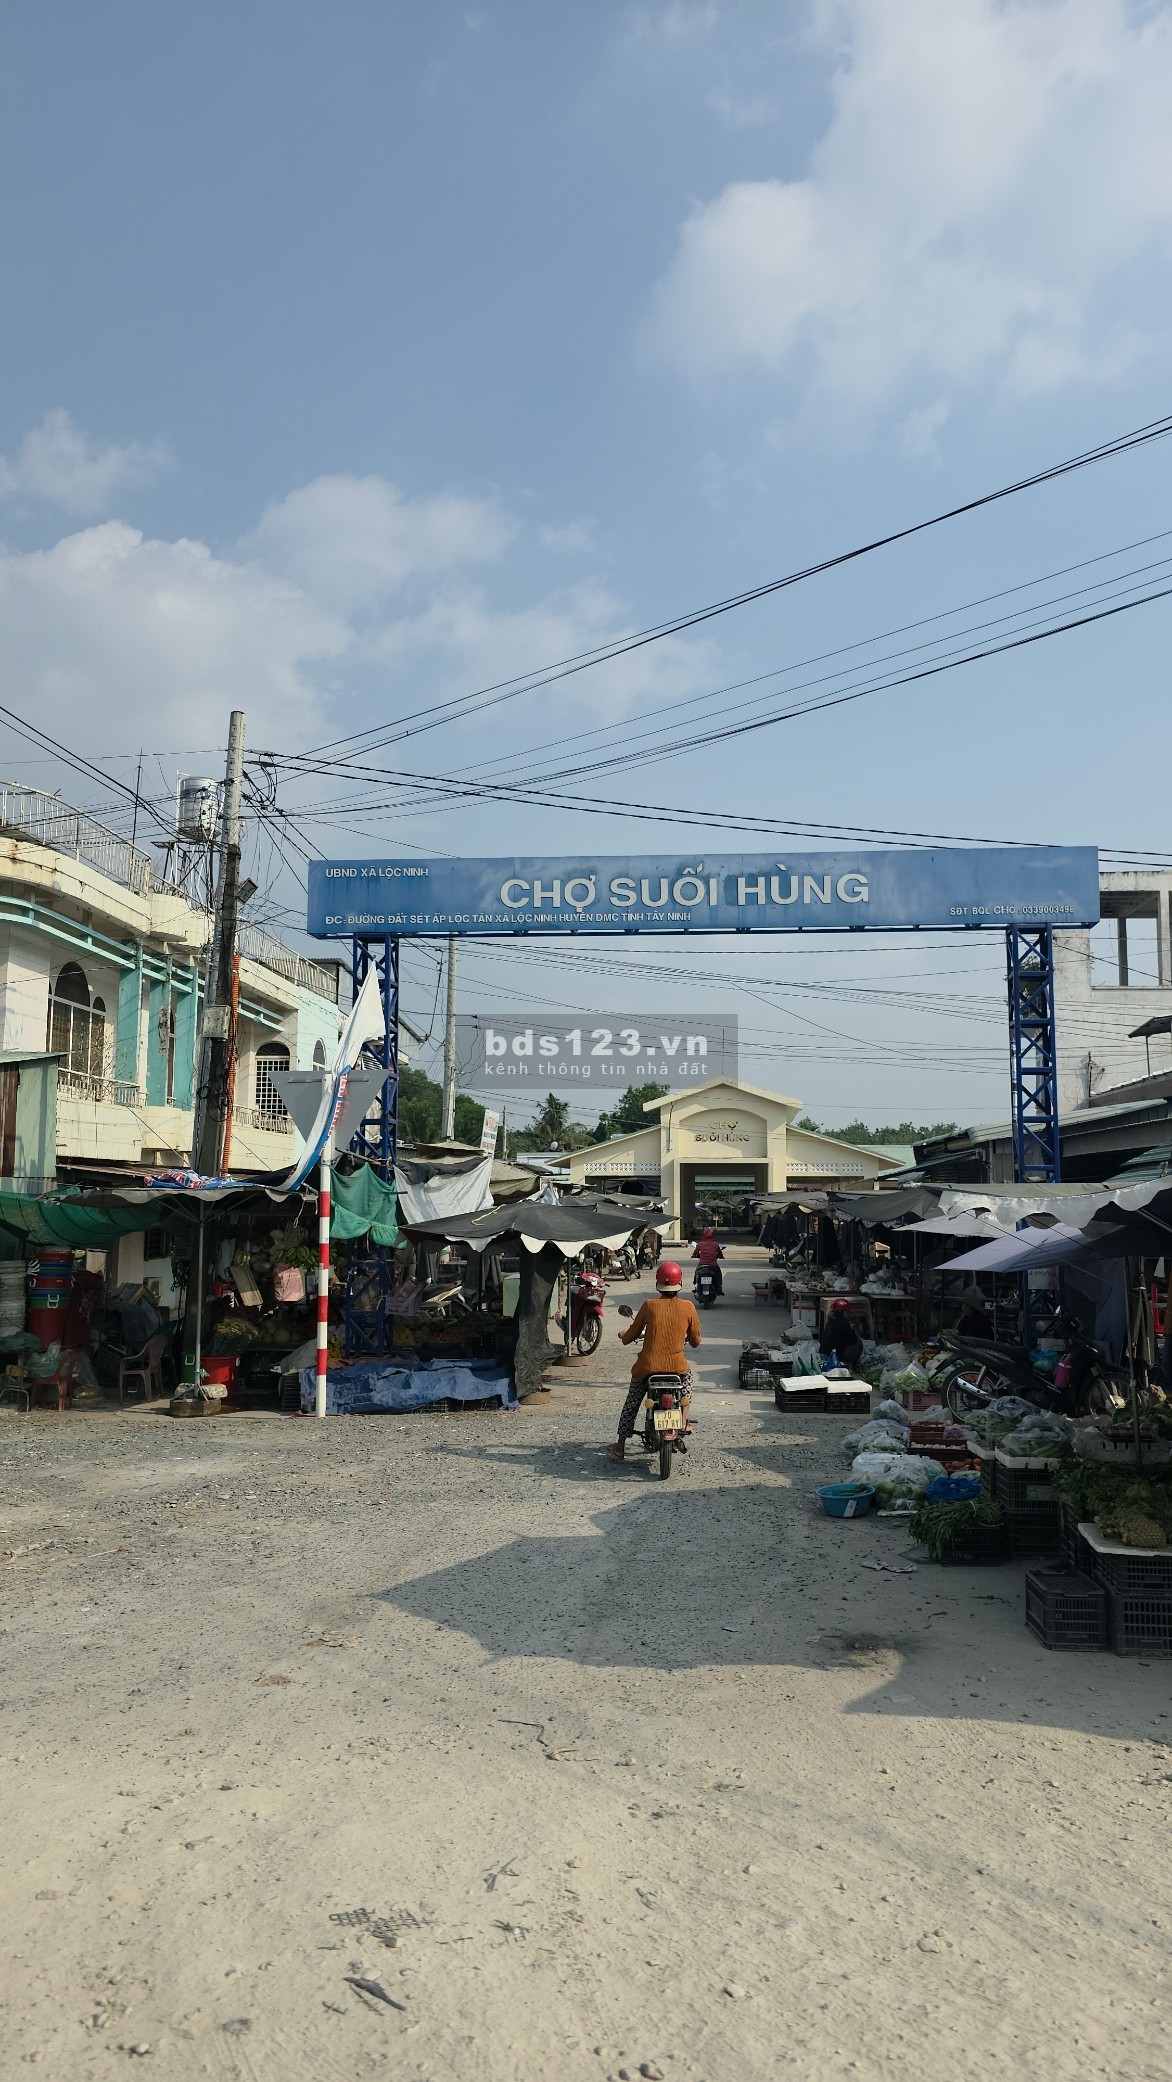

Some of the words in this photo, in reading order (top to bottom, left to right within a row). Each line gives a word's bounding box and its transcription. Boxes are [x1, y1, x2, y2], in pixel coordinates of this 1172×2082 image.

[325, 868, 358, 878] UBND
[361, 865, 377, 877] XÃ
[379, 865, 402, 880] LỘC
[403, 867, 429, 877] NINH
[501, 875, 598, 912] CHỢ
[609, 863, 718, 907] SUỐI
[737, 863, 870, 906] HÙNG
[347, 912, 385, 924] ĐƯỜNG
[387, 912, 408, 924] ĐẤT
[432, 912, 446, 924] ẤP
[448, 912, 470, 926] LỘC
[495, 912, 511, 923] XÃ
[511, 911, 533, 925] LỘC
[534, 912, 557, 923] NINH
[559, 911, 593, 924] HUYỆN
[595, 912, 619, 922] DMC
[646, 910, 664, 921] TÂY
[667, 911, 691, 921] NINH
[949, 907, 968, 916] SĐT
[971, 906, 991, 915] BQL
